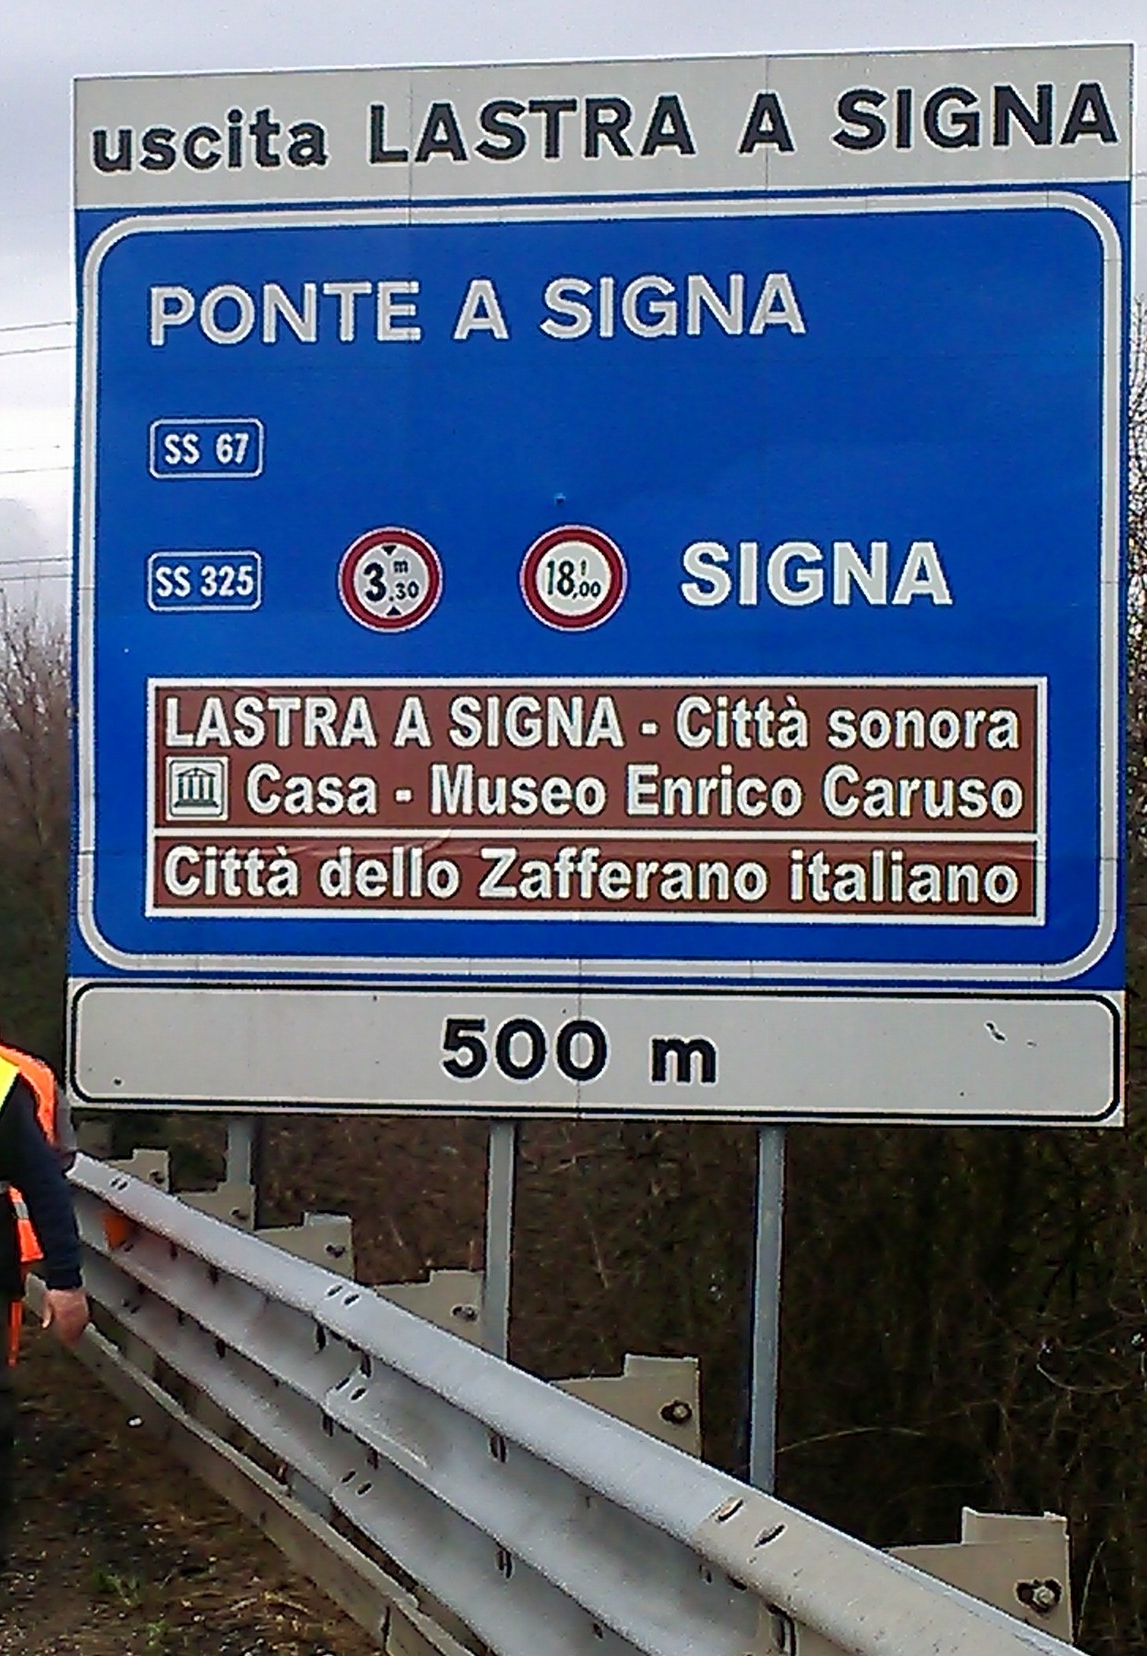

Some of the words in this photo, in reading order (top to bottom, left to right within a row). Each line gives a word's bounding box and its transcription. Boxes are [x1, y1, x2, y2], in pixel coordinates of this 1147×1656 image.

[92, 107, 328, 173] uscita
[369, 93, 696, 165] LASTRA
[739, 91, 796, 155] A
[831, 80, 1121, 149] SIGNA
[150, 278, 422, 347] PONTE
[453, 276, 510, 341] A
[538, 271, 807, 339] SIGNA
[164, 432, 201, 465] SS
[215, 432, 250, 465] 67
[155, 565, 192, 598] SS
[200, 564, 254, 597] 325
[679, 539, 954, 608] SIGNA
[164, 694, 377, 750] LASTRA
[393, 695, 432, 750] A
[450, 694, 625, 750] SIGNA
[675, 694, 810, 751] Città
[826, 705, 1020, 750] sonora
[246, 766, 379, 817] Casa
[429, 766, 608, 818] Museo
[625, 765, 804, 819] Enrico
[821, 766, 1025, 820] Caruso
[163, 844, 301, 900] Città
[317, 845, 460, 901] dello
[478, 846, 769, 904] Zafferano
[789, 848, 1020, 905] italiano
[441, 1018, 610, 1083] 500
[651, 1035, 720, 1085] m
